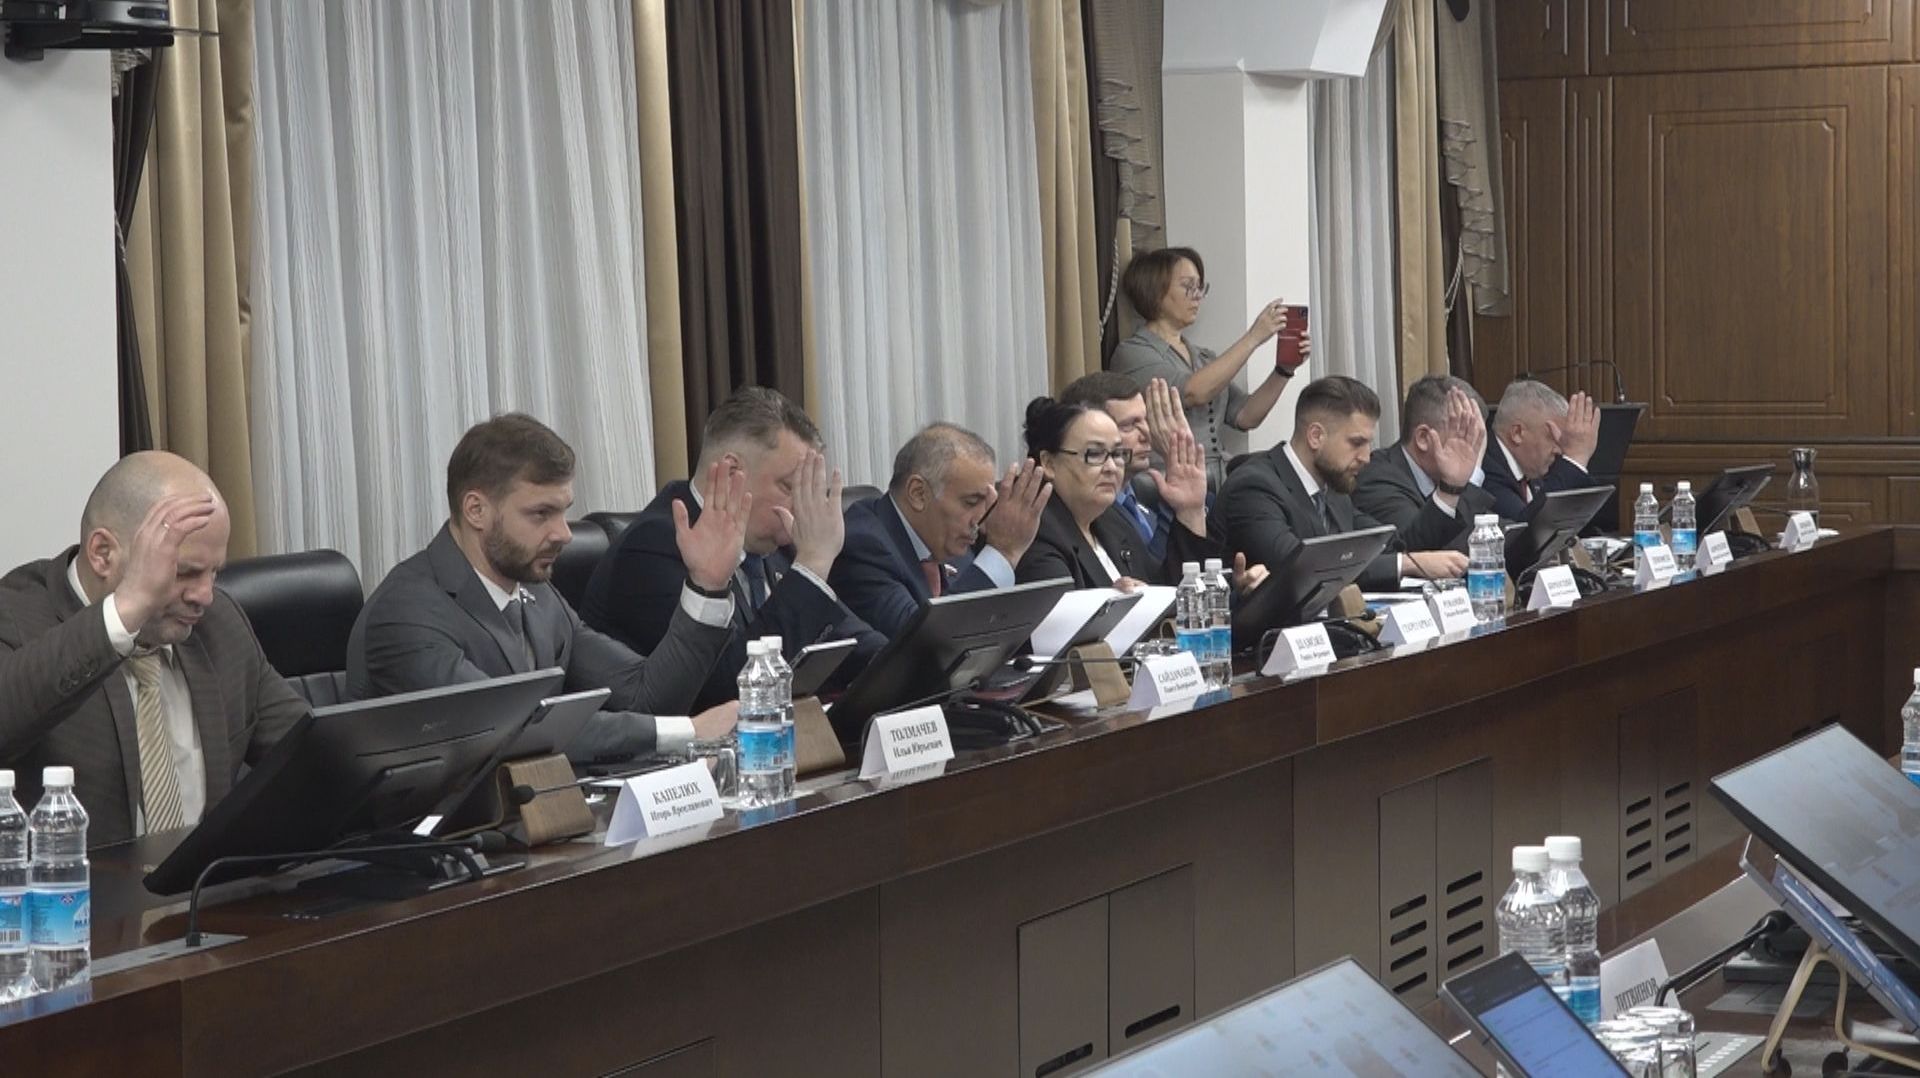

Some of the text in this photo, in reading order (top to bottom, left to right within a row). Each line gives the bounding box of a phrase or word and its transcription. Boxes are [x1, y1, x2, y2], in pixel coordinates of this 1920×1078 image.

[890, 720, 938, 742] ТОЛМАЧЕВ
[652, 782, 702, 805] КАПЕЛЮХ
[650, 809, 672, 821] Игорь
[1614, 978, 1660, 1014] ЛИТВИНОВ
